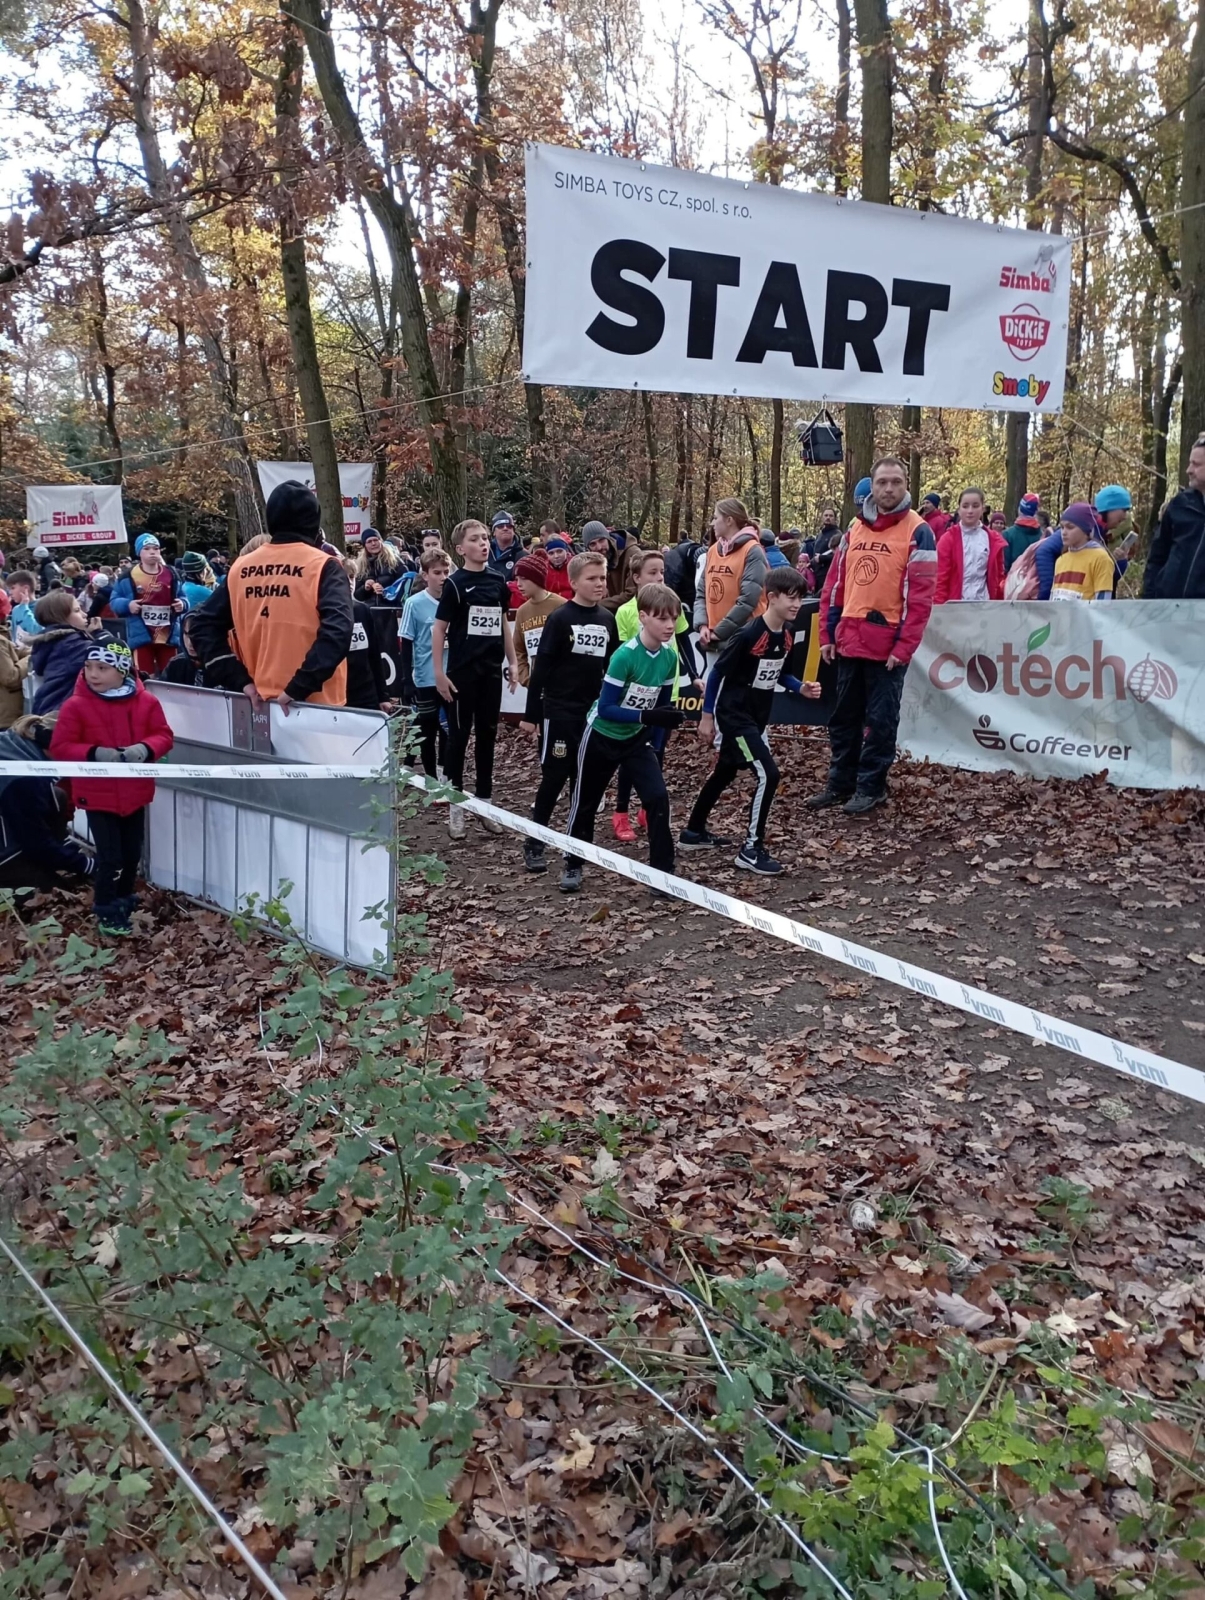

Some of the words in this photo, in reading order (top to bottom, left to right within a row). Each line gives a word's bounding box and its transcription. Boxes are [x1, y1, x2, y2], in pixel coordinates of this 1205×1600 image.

[554, 171, 607, 195] SIMBA
[612, 180, 653, 203] TOYS
[658, 189, 682, 209] CZ,
[686, 196, 719, 214] spol.
[722, 203, 729, 215] s
[733, 204, 752, 219] r.o.
[999, 266, 1050, 293] Simba
[585, 238, 951, 376] START
[1016, 338, 1032, 347] TOYS
[993, 370, 1050, 406] Smoby
[53, 511, 95, 526] Simba
[852, 541, 892, 554] ALEA
[240, 564, 305, 579] SPARTAK
[245, 584, 290, 599] PRAHA
[143, 612, 169, 620] 5242
[260, 605, 270, 618] 4
[471, 616, 500, 628] 5234
[577, 633, 605, 647] 5232
[1010, 733, 1132, 761] Coffeever
